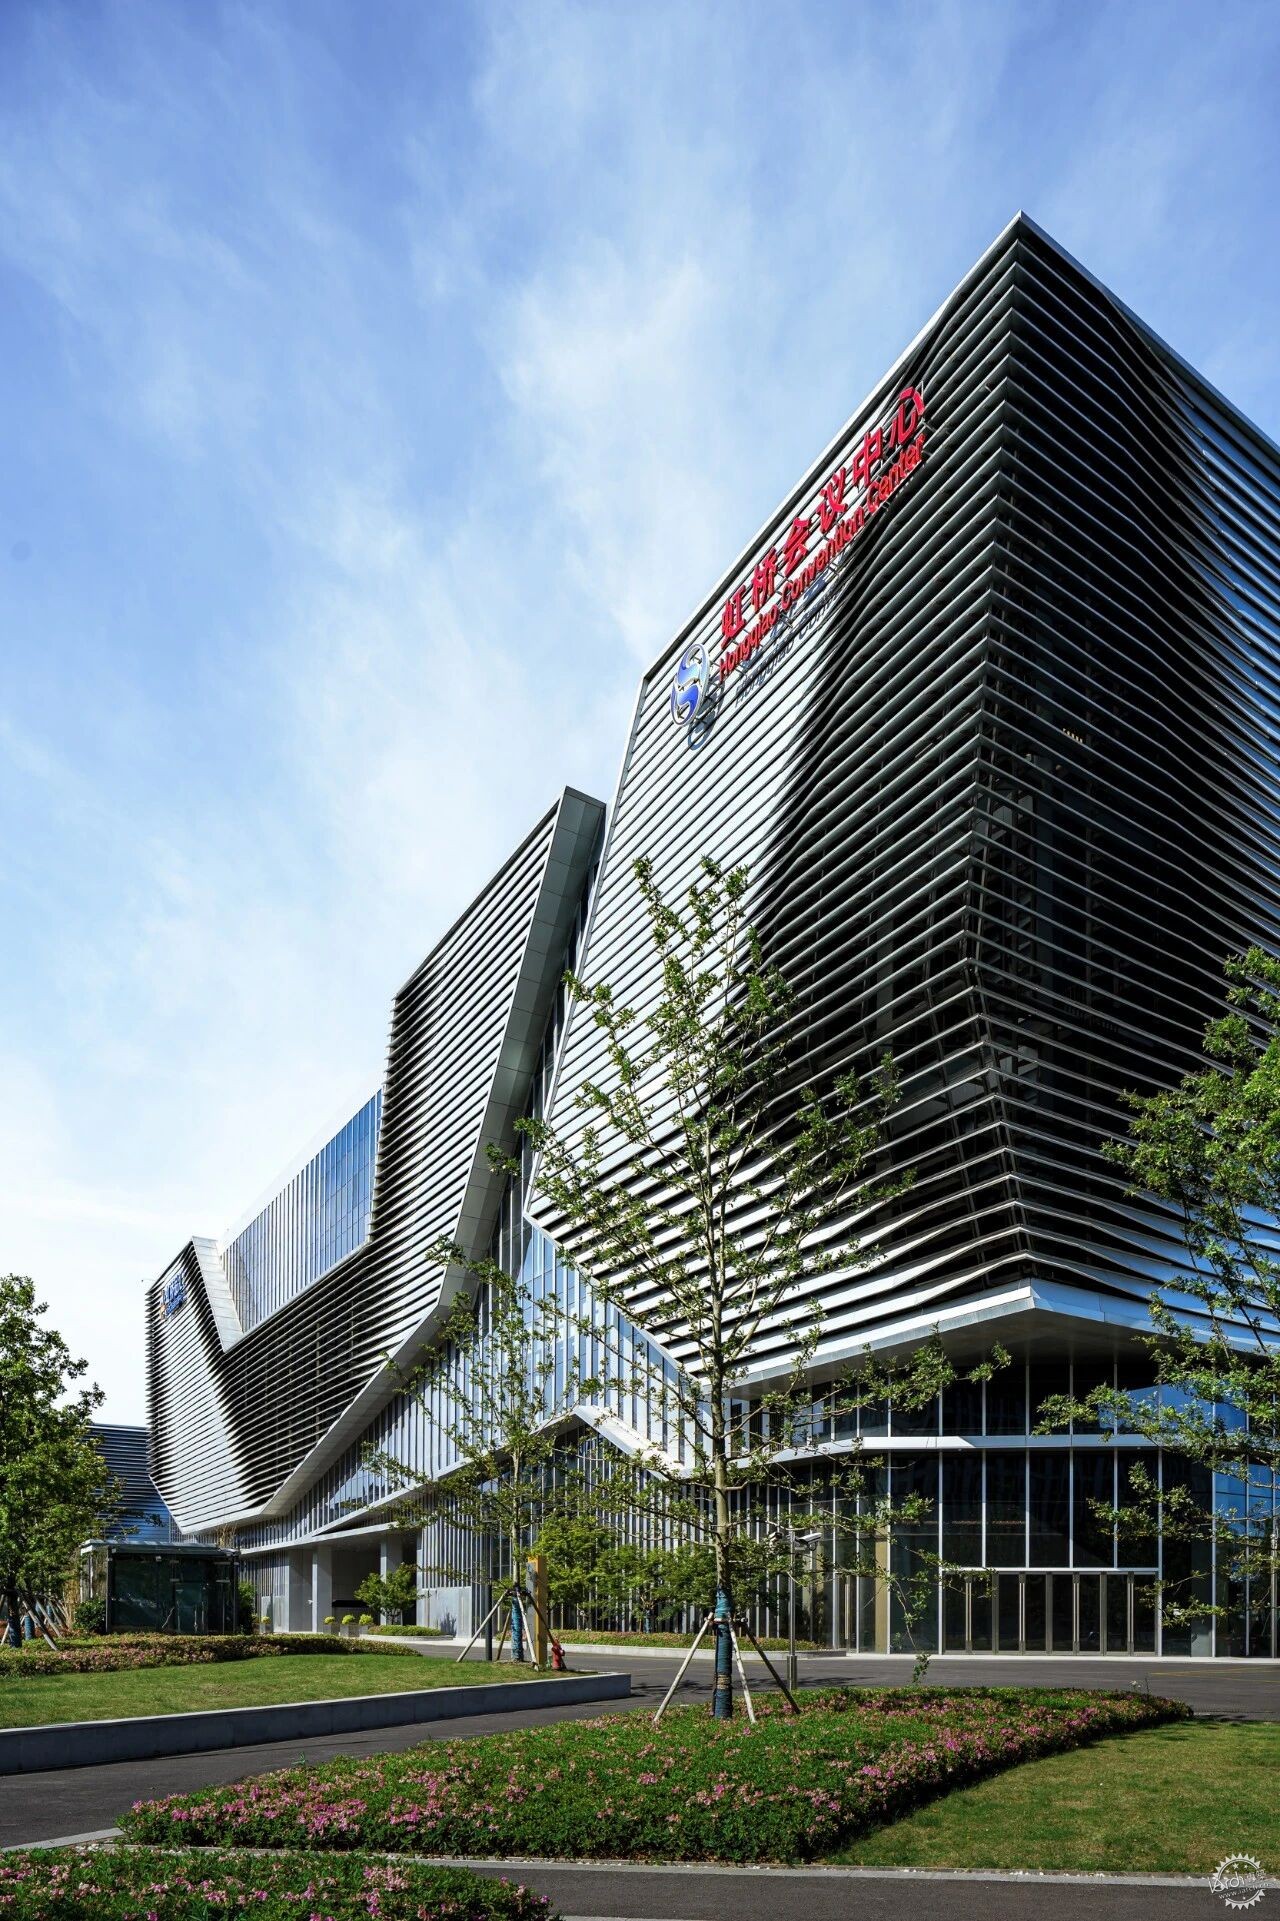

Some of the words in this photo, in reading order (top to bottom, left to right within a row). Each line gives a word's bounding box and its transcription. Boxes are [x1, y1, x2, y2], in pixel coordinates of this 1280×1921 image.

[719, 604, 780, 684] Hongqiao
[780, 506, 866, 611] Convention
[866, 432, 926, 514] Center
[720, 386, 926, 650] 虹桥会议中心
